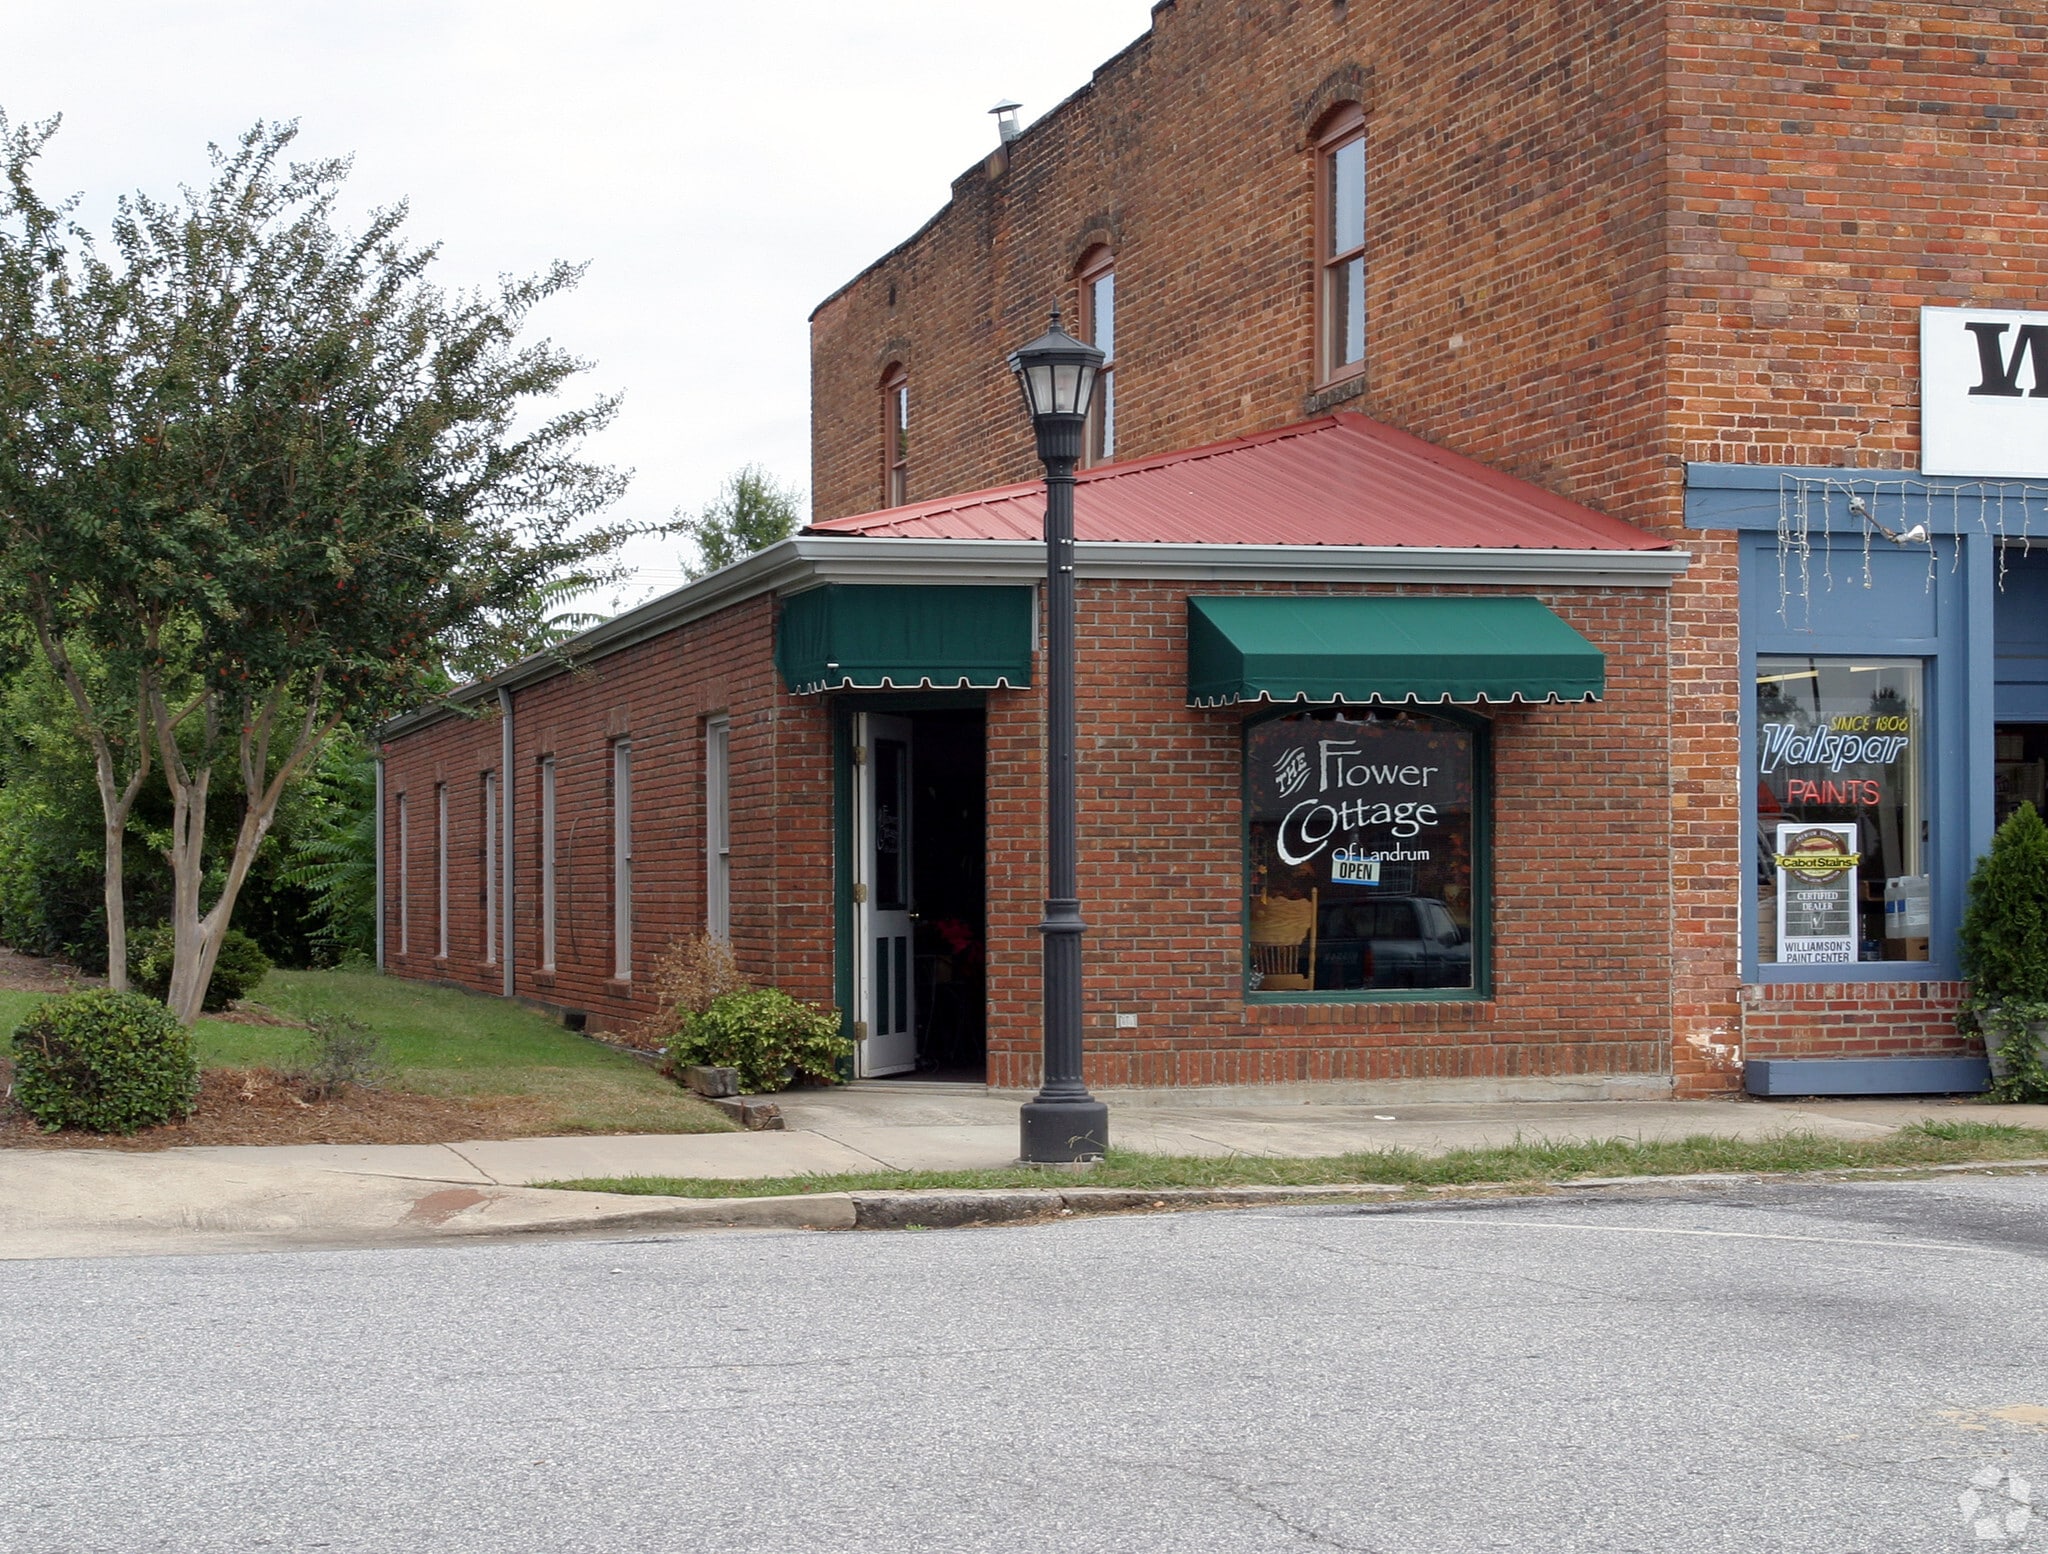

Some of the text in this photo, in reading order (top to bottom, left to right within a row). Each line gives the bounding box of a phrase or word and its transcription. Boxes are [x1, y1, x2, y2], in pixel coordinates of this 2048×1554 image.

[1829, 716, 1909, 731] SINCE 1806
[1760, 723, 1909, 773] Valspar
[1275, 740, 1439, 792] THE Flower
[1787, 779, 1881, 805] PAINTS
[1277, 799, 1438, 865] Cottage
[1332, 842, 1430, 862] Of Landrum
[1339, 862, 1373, 880] OPEN
[1796, 892, 1838, 900] CERTIFIED
[1802, 902, 1834, 911] DEALER
[1785, 941, 1851, 952] WILLIAMSON'S
[1786, 952, 1849, 963] PAINT CENTER
